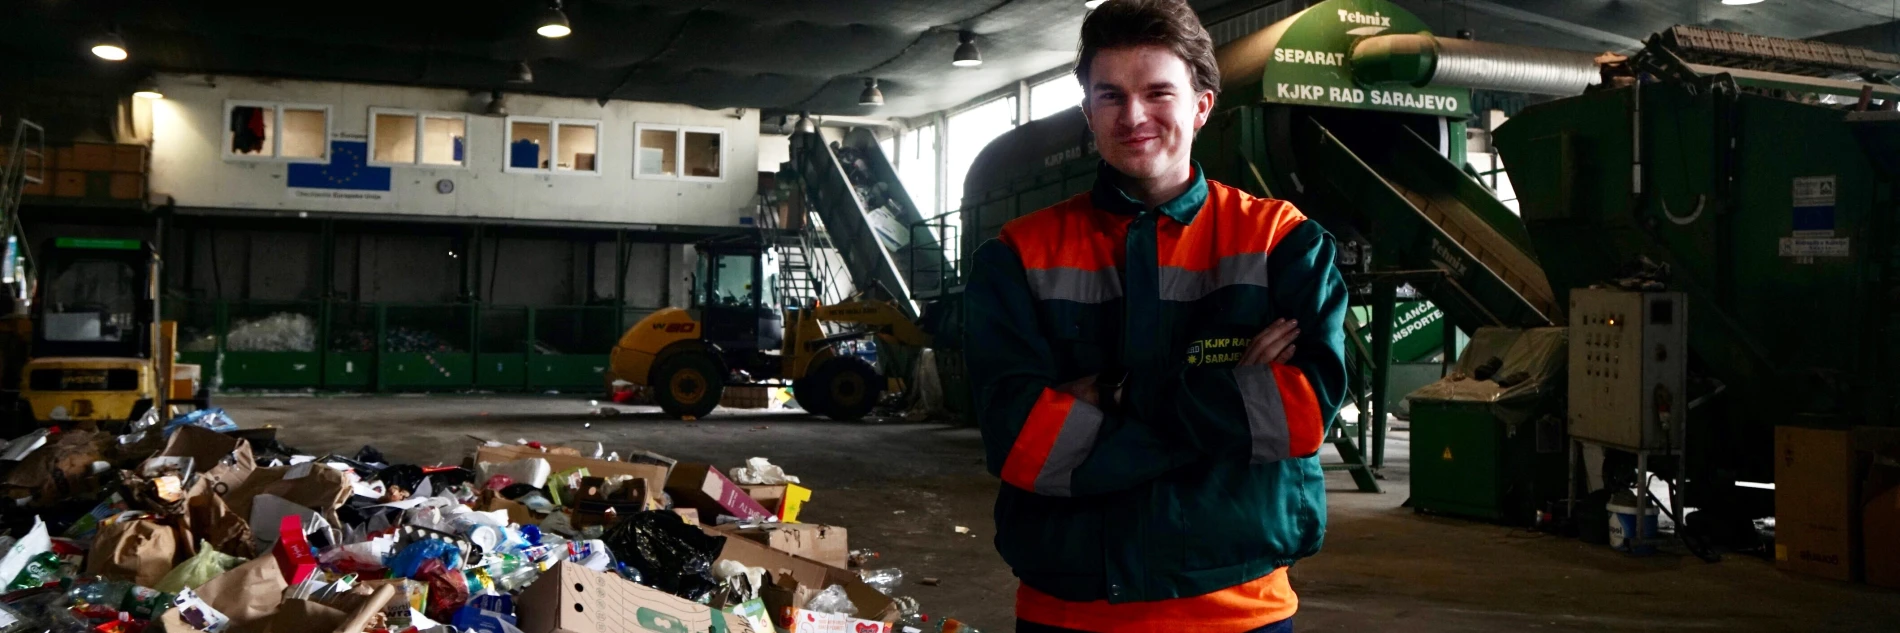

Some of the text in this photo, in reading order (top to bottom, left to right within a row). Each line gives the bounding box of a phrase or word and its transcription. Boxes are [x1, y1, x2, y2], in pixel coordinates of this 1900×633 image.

[1337, 9, 1391, 27] Tehnix
[1274, 47, 1345, 67] SEPARAT
[1277, 83, 1458, 112] KJKP RAD SARAJEVO
[1392, 308, 1445, 344] NSPORTE
[1205, 338, 1231, 349] KJKP
